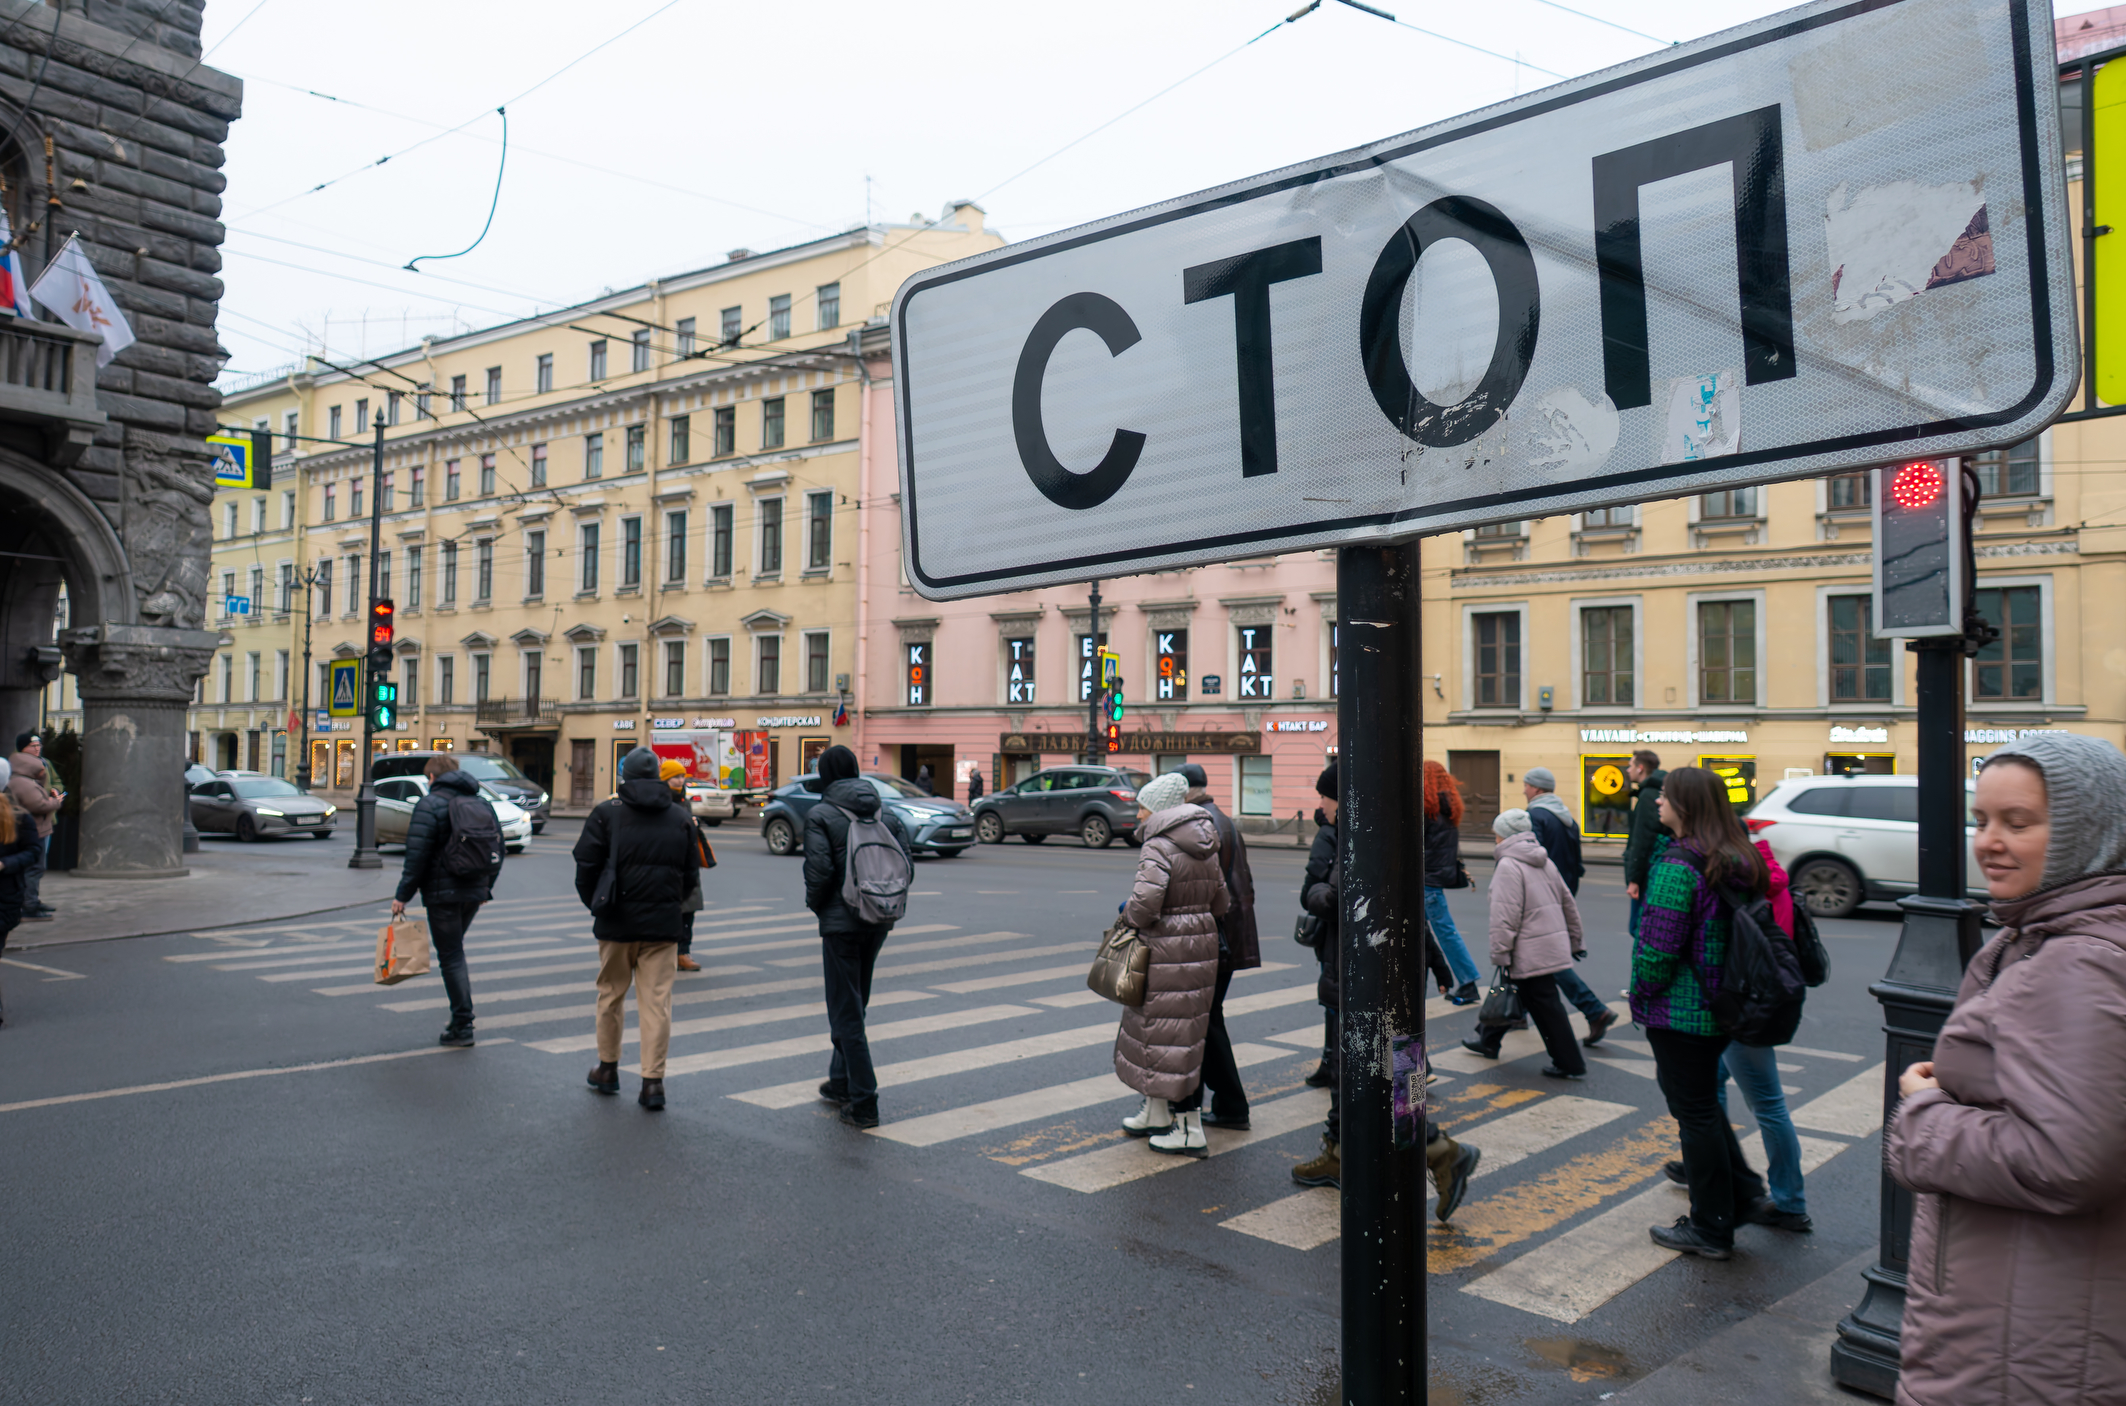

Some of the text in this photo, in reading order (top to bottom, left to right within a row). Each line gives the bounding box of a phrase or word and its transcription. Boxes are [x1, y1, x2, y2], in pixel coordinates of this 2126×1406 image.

[1012, 103, 1798, 511] СТОП
[910, 645, 924, 705] КОН
[1159, 633, 1174, 699] КОН
[756, 715, 821, 728] КОНДИТЕРСКАЯ
[1266, 721, 1328, 732] КОНТАКТ БАР
